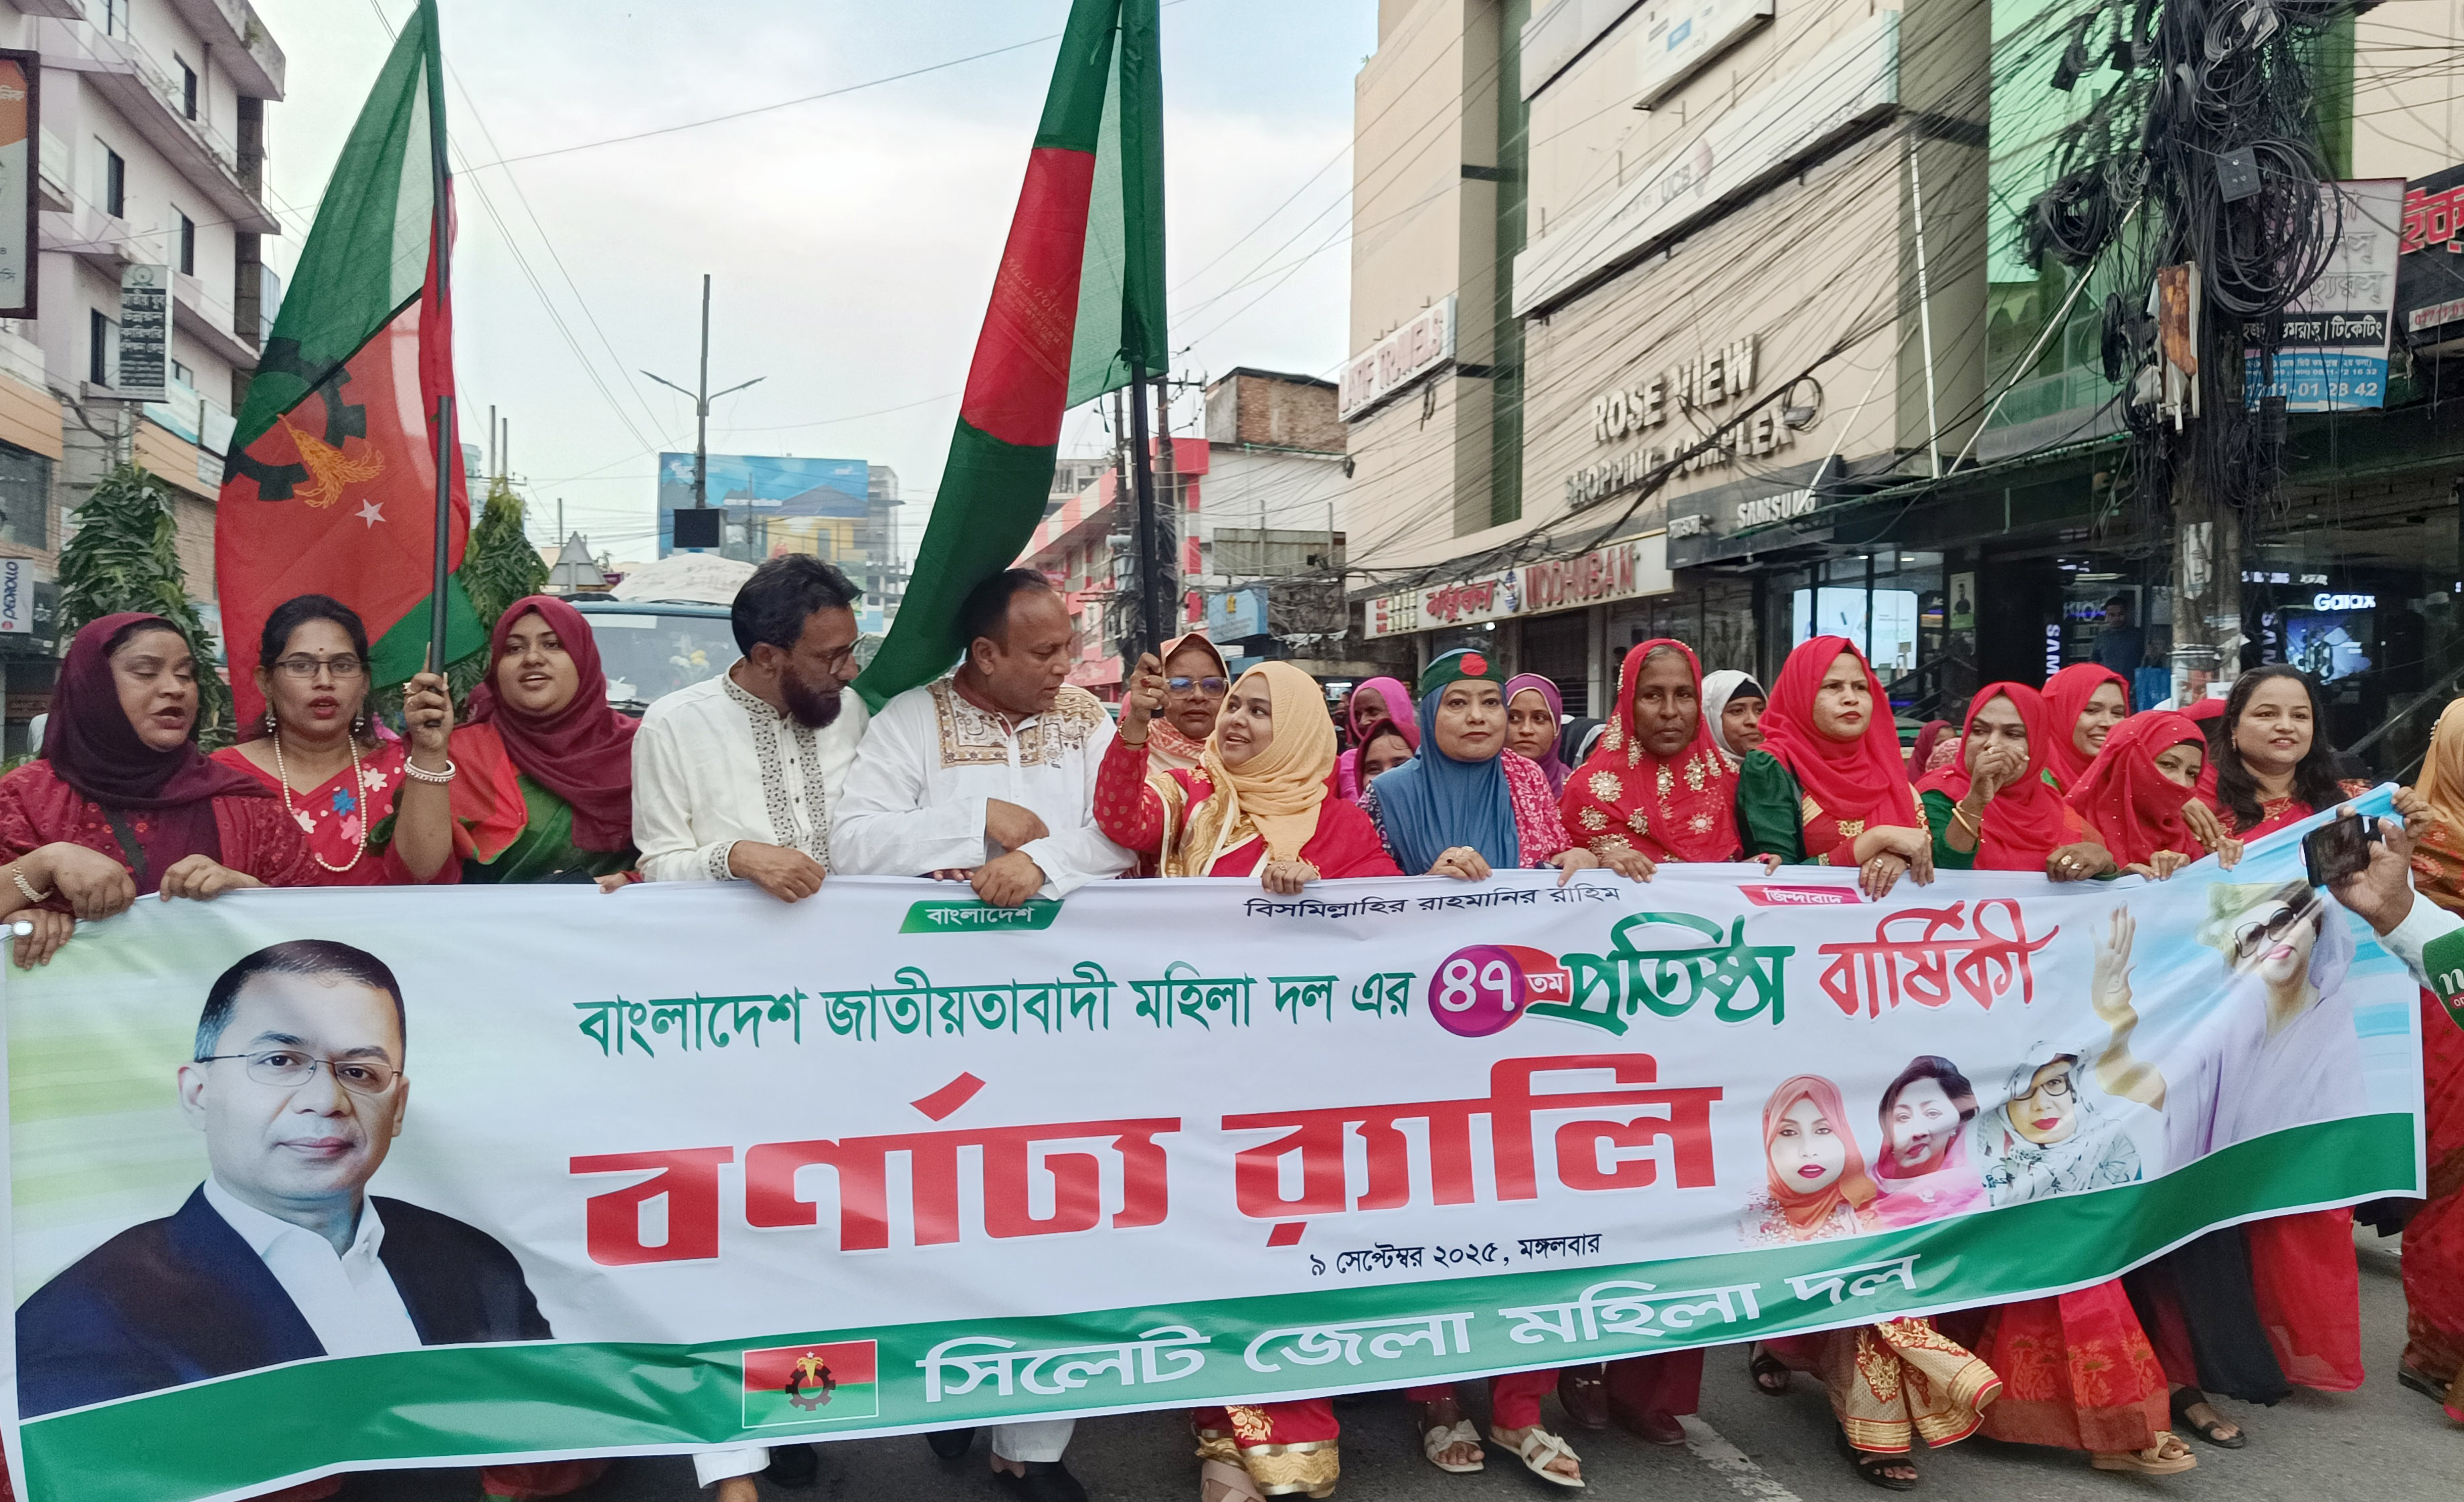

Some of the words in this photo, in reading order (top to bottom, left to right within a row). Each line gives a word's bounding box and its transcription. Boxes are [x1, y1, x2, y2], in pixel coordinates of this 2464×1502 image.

[2331, 315, 2383, 340] টিকেটিং
[1591, 376, 1666, 442] ROSE
[1673, 334, 1761, 407] VIEW
[924, 906, 1036, 926] বাংলাদেশ
[1243, 896, 1409, 919] বিসমিল্লাহির
[1417, 887, 1539, 912] রাহমানির
[1547, 883, 1621, 904] রাহিম
[1761, 887, 1843, 904] জিন্দাবাদ
[1438, 958, 1516, 1013] ৪৭
[1525, 911, 1796, 1037] প্রতিষ্ঠা
[1526, 973, 1565, 995] তম
[1818, 898, 2060, 1020] বার্ষিকী
[573, 986, 809, 1059] বাংলাদেশ
[818, 961, 1118, 1042] জাতীয়তাবাদী
[1128, 960, 1258, 1032] মহিলা
[1267, 975, 1340, 1024] দল
[1351, 971, 1417, 1019] এর
[569, 1070, 1182, 1266] বর্ণাঢ্য
[1336, 1241, 1425, 1274] সেপ্টেম্বর
[1517, 1232, 1603, 1260] মঙ্গলবার
[915, 1324, 1212, 1403] সিলেট
[1243, 1311, 1476, 1373] জেলা
[1498, 1279, 1762, 1345] মহিলা
[1783, 1253, 1922, 1306] দল
